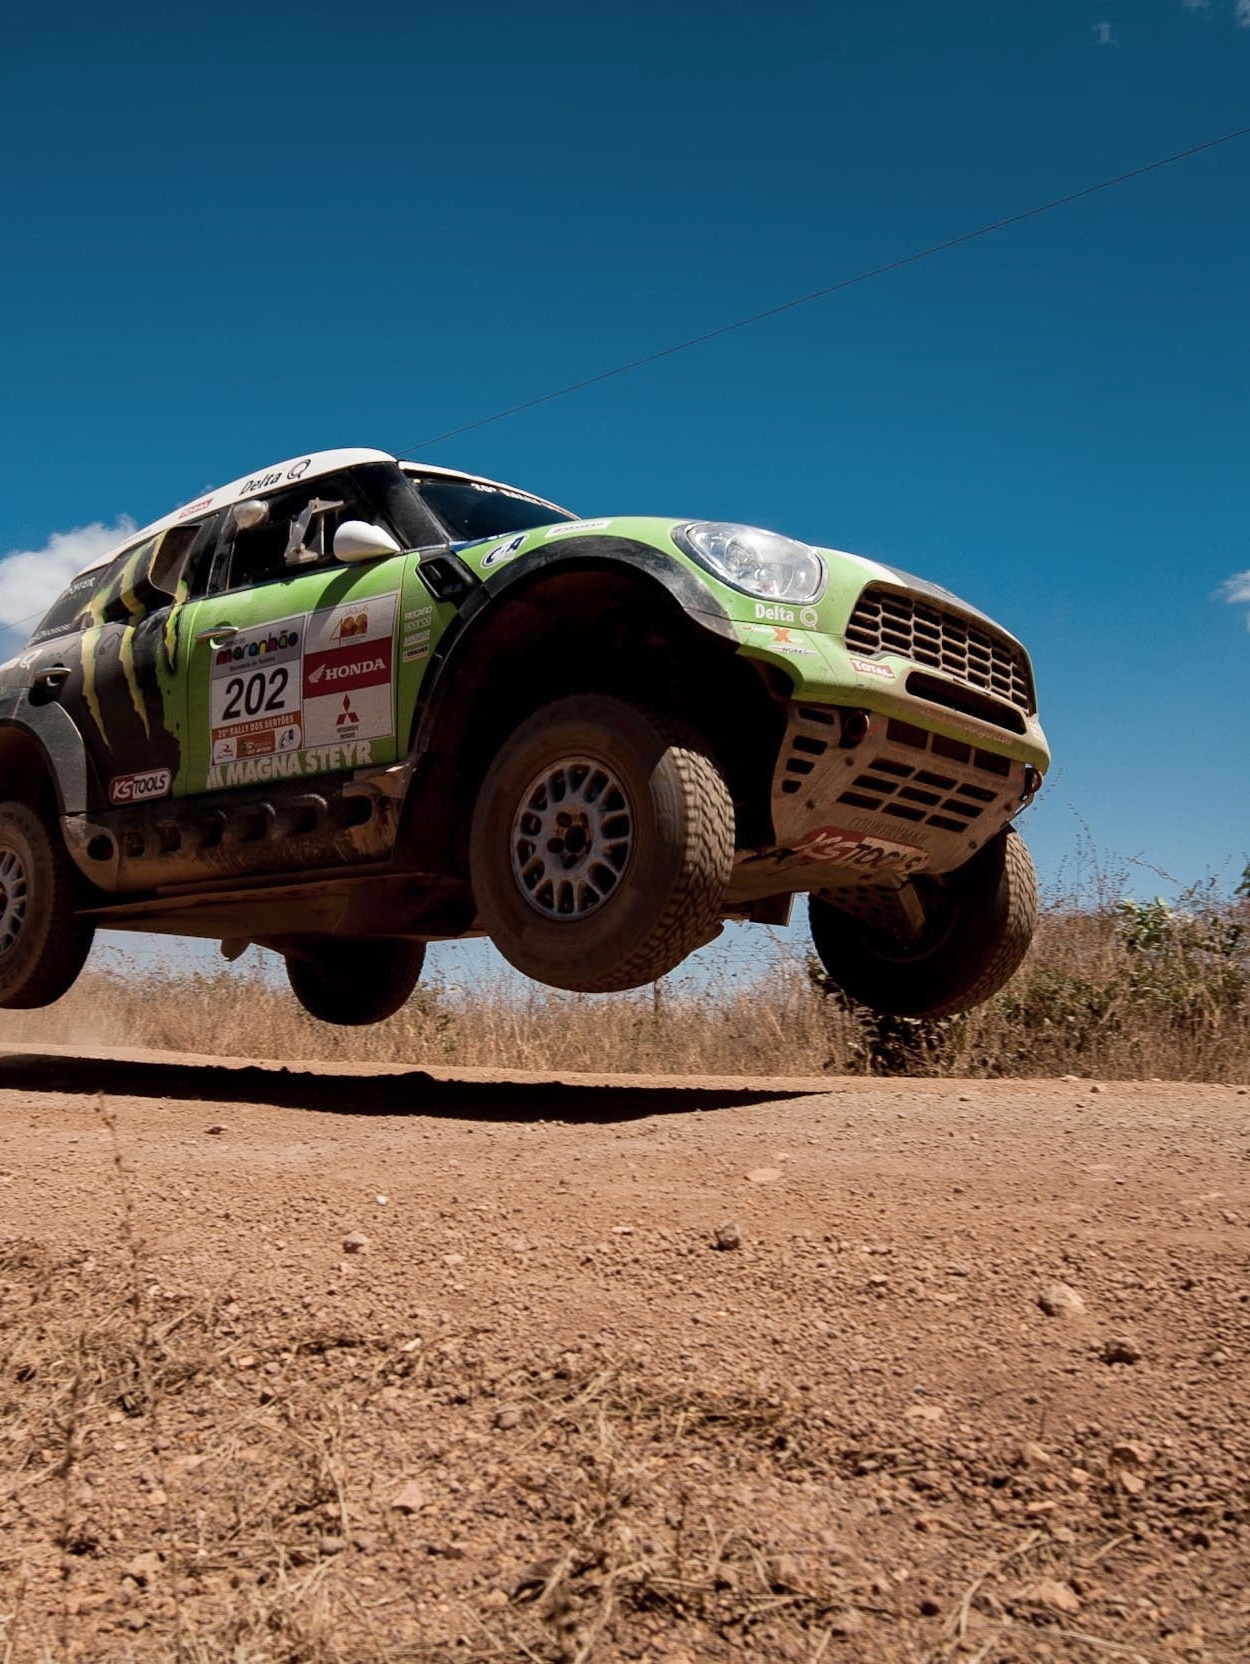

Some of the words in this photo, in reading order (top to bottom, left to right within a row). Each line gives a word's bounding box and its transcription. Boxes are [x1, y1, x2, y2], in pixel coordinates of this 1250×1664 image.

[239, 471, 282, 496] Delta
[755, 603, 795, 622] Delta
[325, 657, 387, 681] HONDA
[851, 659, 895, 678] TOTAL
[222, 667, 289, 721] 202
[230, 724, 249, 735] RALLY
[250, 720, 264, 731] DOS
[226, 752, 303, 786] MAGNA
[305, 741, 373, 773] STEYR
[113, 780, 134, 800] KS
[134, 774, 168, 795] TOOLS
